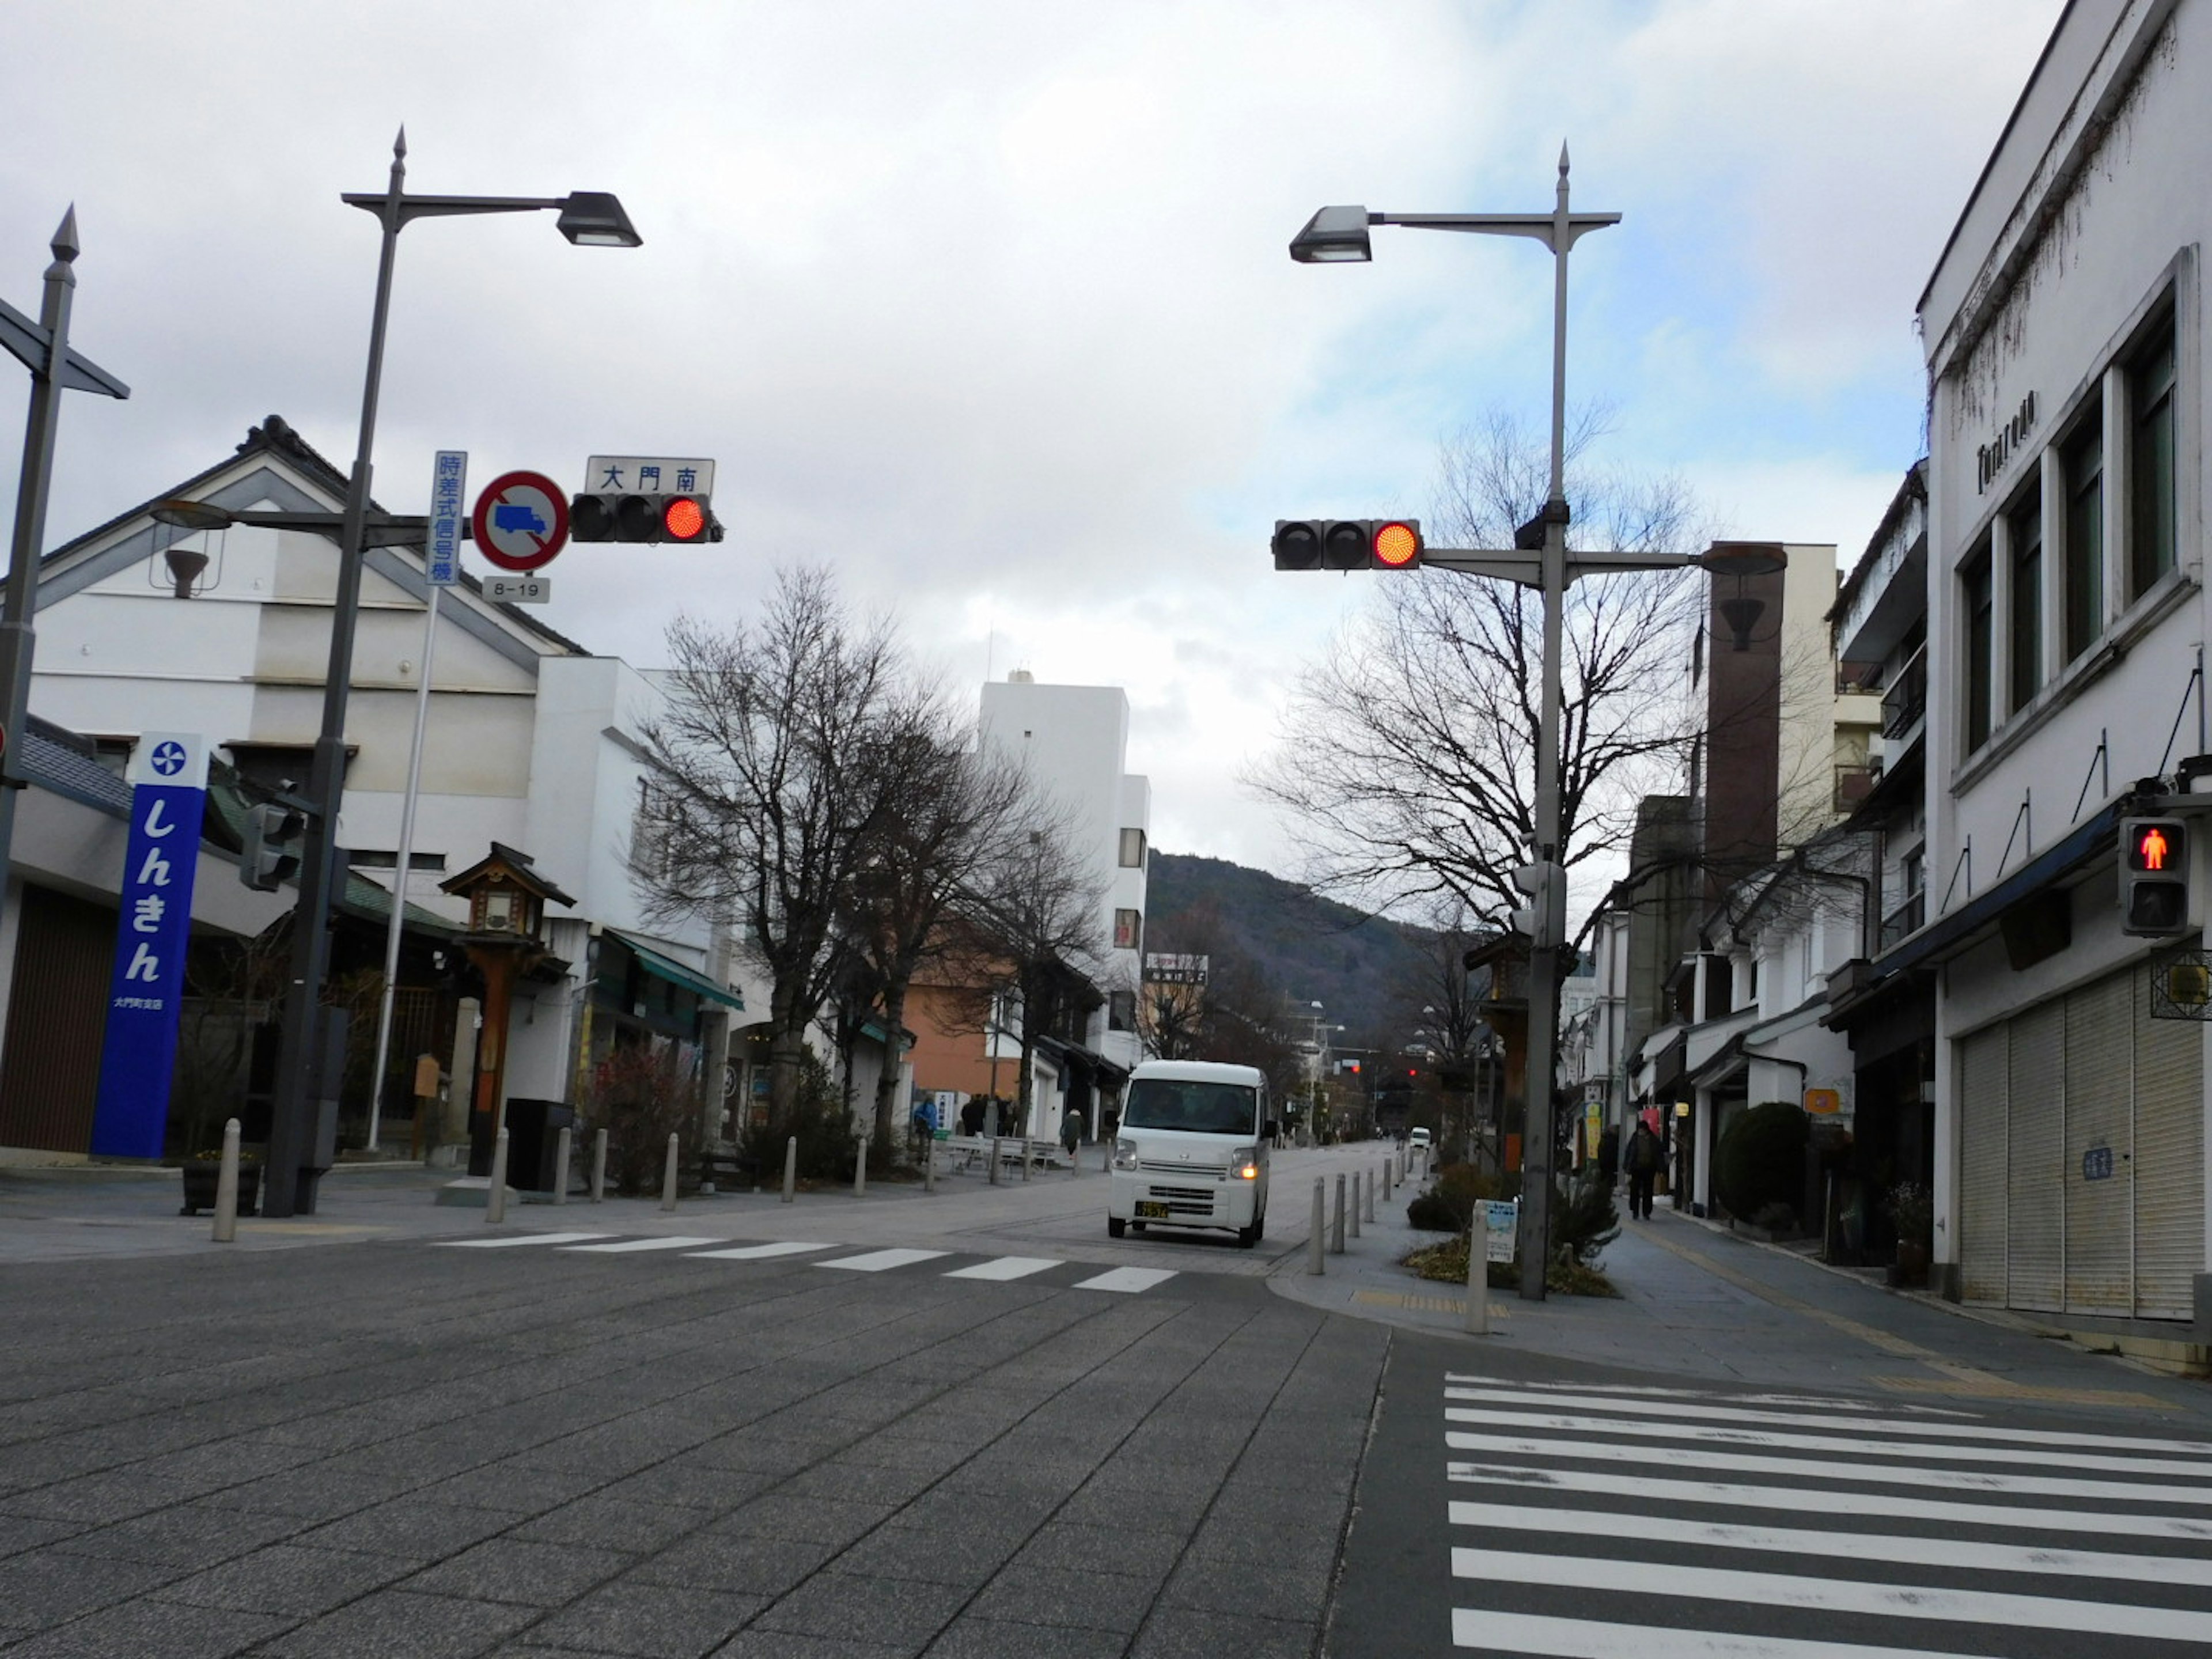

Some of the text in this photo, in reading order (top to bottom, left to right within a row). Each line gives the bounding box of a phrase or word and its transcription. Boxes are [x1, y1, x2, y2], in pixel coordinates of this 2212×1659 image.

[601, 465, 697, 492] 大門南
[431, 456, 460, 581] 時差式信号機
[494, 584, 539, 597] 8-19
[125, 799, 175, 983] しんきん
[113, 997, 164, 1011] 大門町支店
